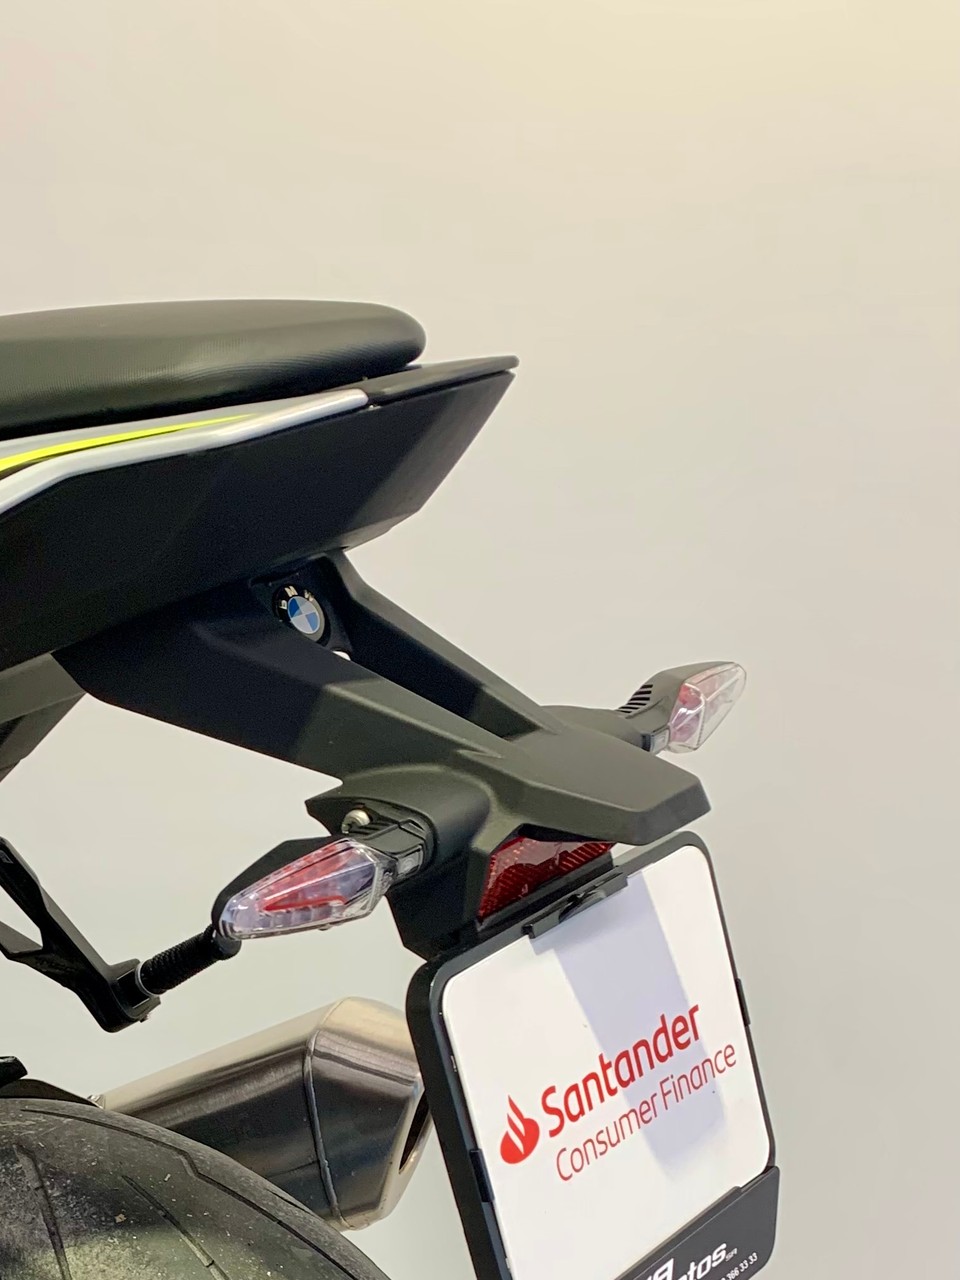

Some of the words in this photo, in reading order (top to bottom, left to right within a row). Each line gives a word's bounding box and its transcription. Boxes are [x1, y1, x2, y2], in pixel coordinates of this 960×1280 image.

[541, 1004, 699, 1137] Santander
[556, 1093, 657, 1181] Consumer
[659, 1044, 737, 1110] Finance
[739, 1260, 749, 1272] 33
[748, 1252, 758, 1265] 33
